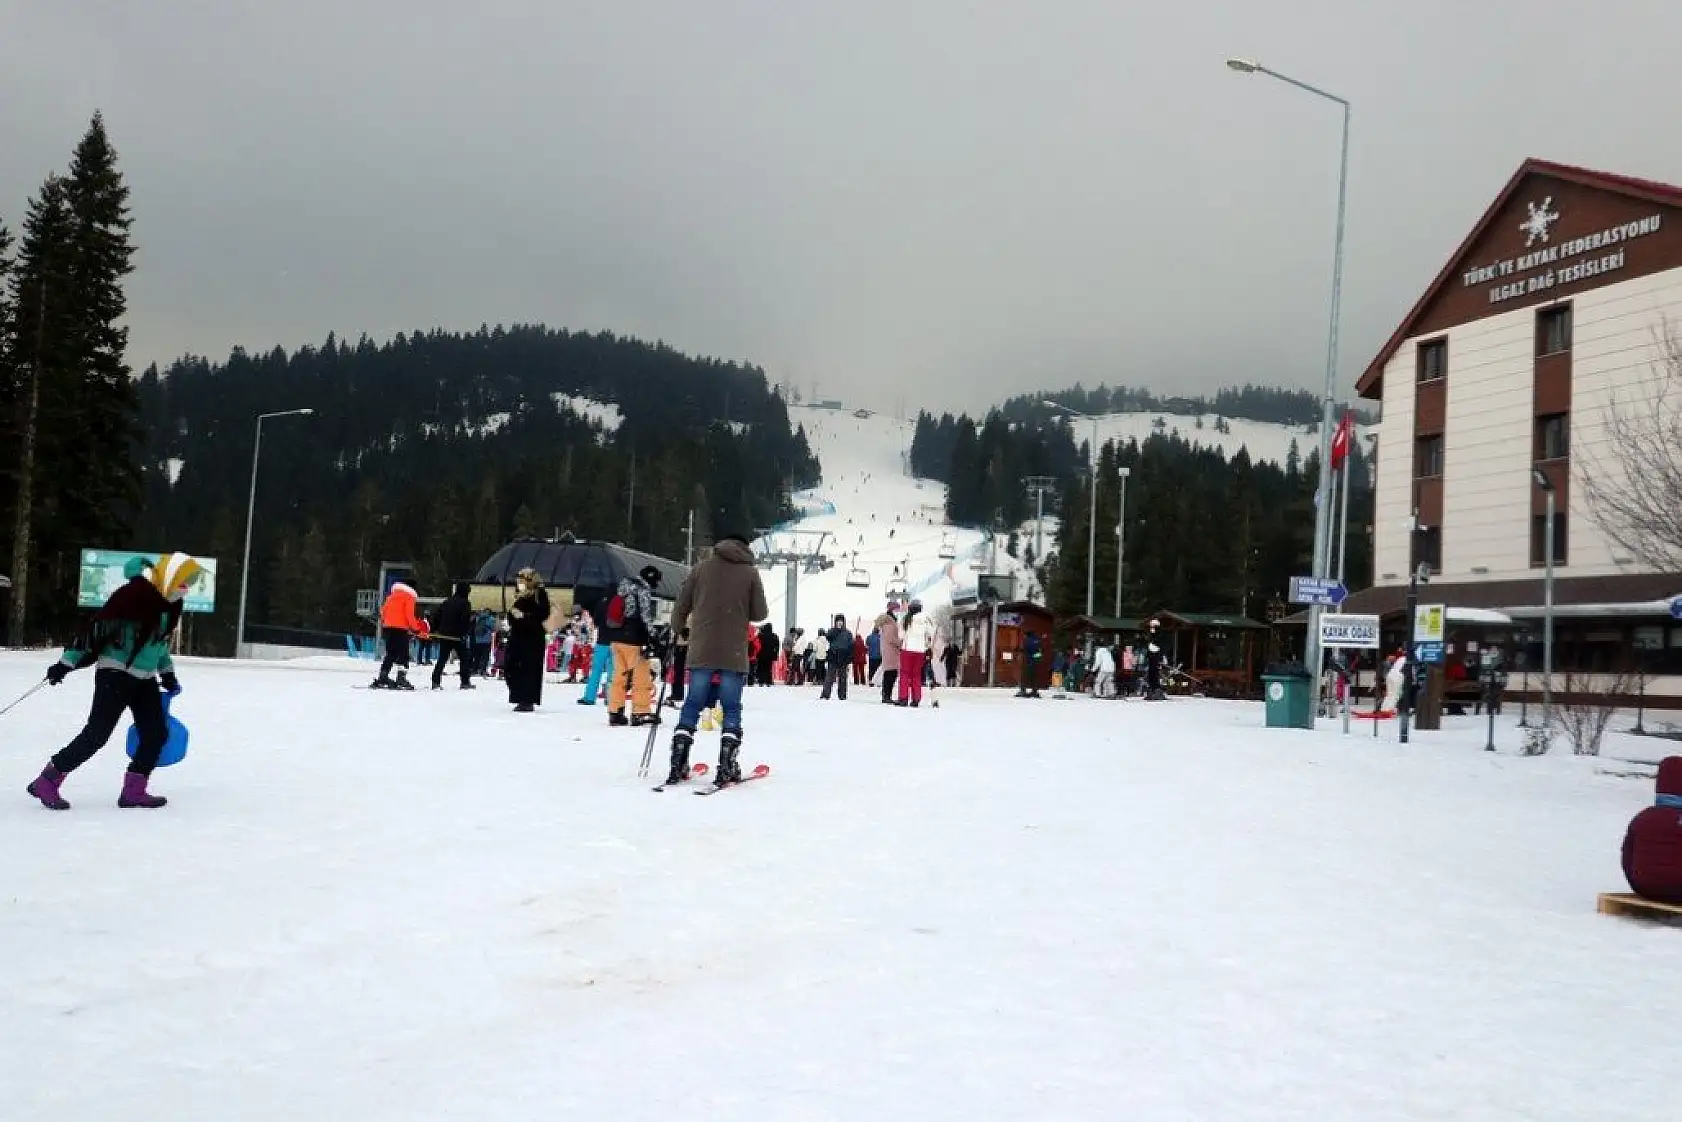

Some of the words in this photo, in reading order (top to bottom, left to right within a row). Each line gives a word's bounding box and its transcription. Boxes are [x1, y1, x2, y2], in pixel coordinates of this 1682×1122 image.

[1517, 246, 1558, 271] KAYAK
[1561, 213, 1661, 258] FEDERASYONU
[1489, 280, 1526, 303] ILGAZ
[1528, 268, 1555, 292] DAĞ
[1557, 247, 1625, 285] TESİSLERİ
